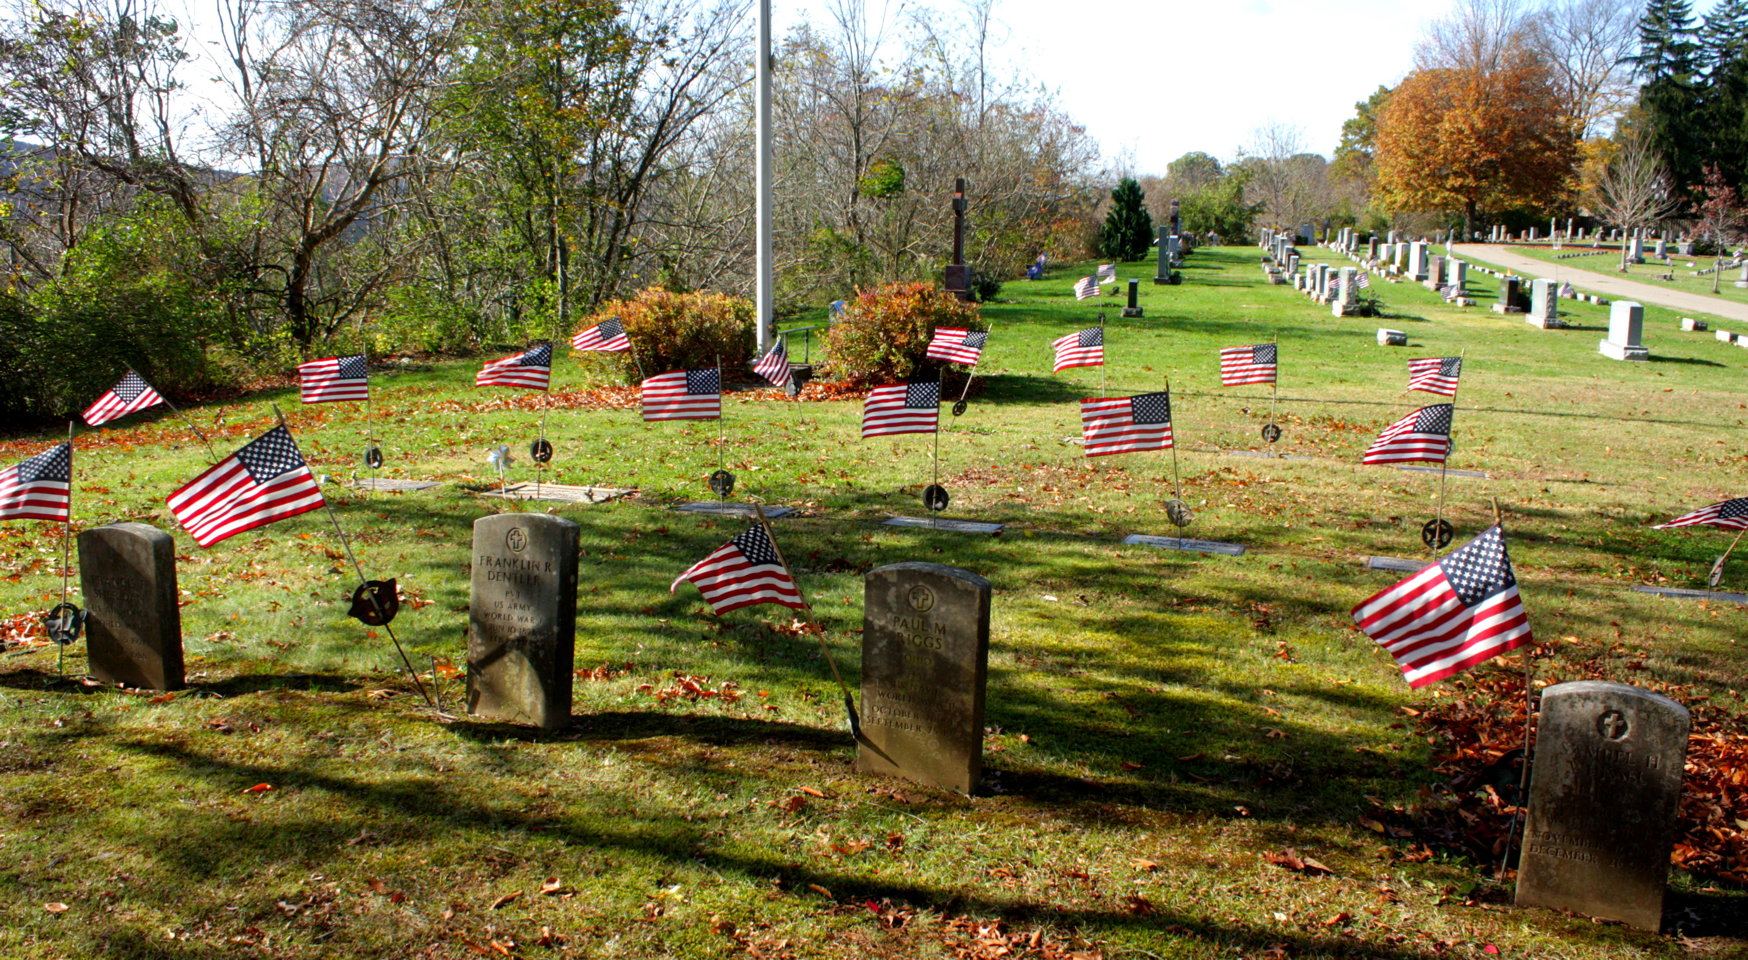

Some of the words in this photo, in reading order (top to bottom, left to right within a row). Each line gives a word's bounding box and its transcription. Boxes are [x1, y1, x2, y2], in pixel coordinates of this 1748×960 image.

[480, 556, 540, 571] FRANKLIN
[545, 562, 552, 572] R
[494, 600, 504, 609] US
[507, 602, 531, 612] ARMY
[484, 612, 513, 621] WORLD
[517, 615, 536, 624] WAR
[893, 616, 931, 631] PAUL
[934, 622, 947, 636] M
[897, 633, 942, 649] RIGGS
[872, 705, 920, 719] OCTOBER
[867, 716, 921, 731] SEPTEMBER
[1531, 844, 1599, 864] DECEMBER
